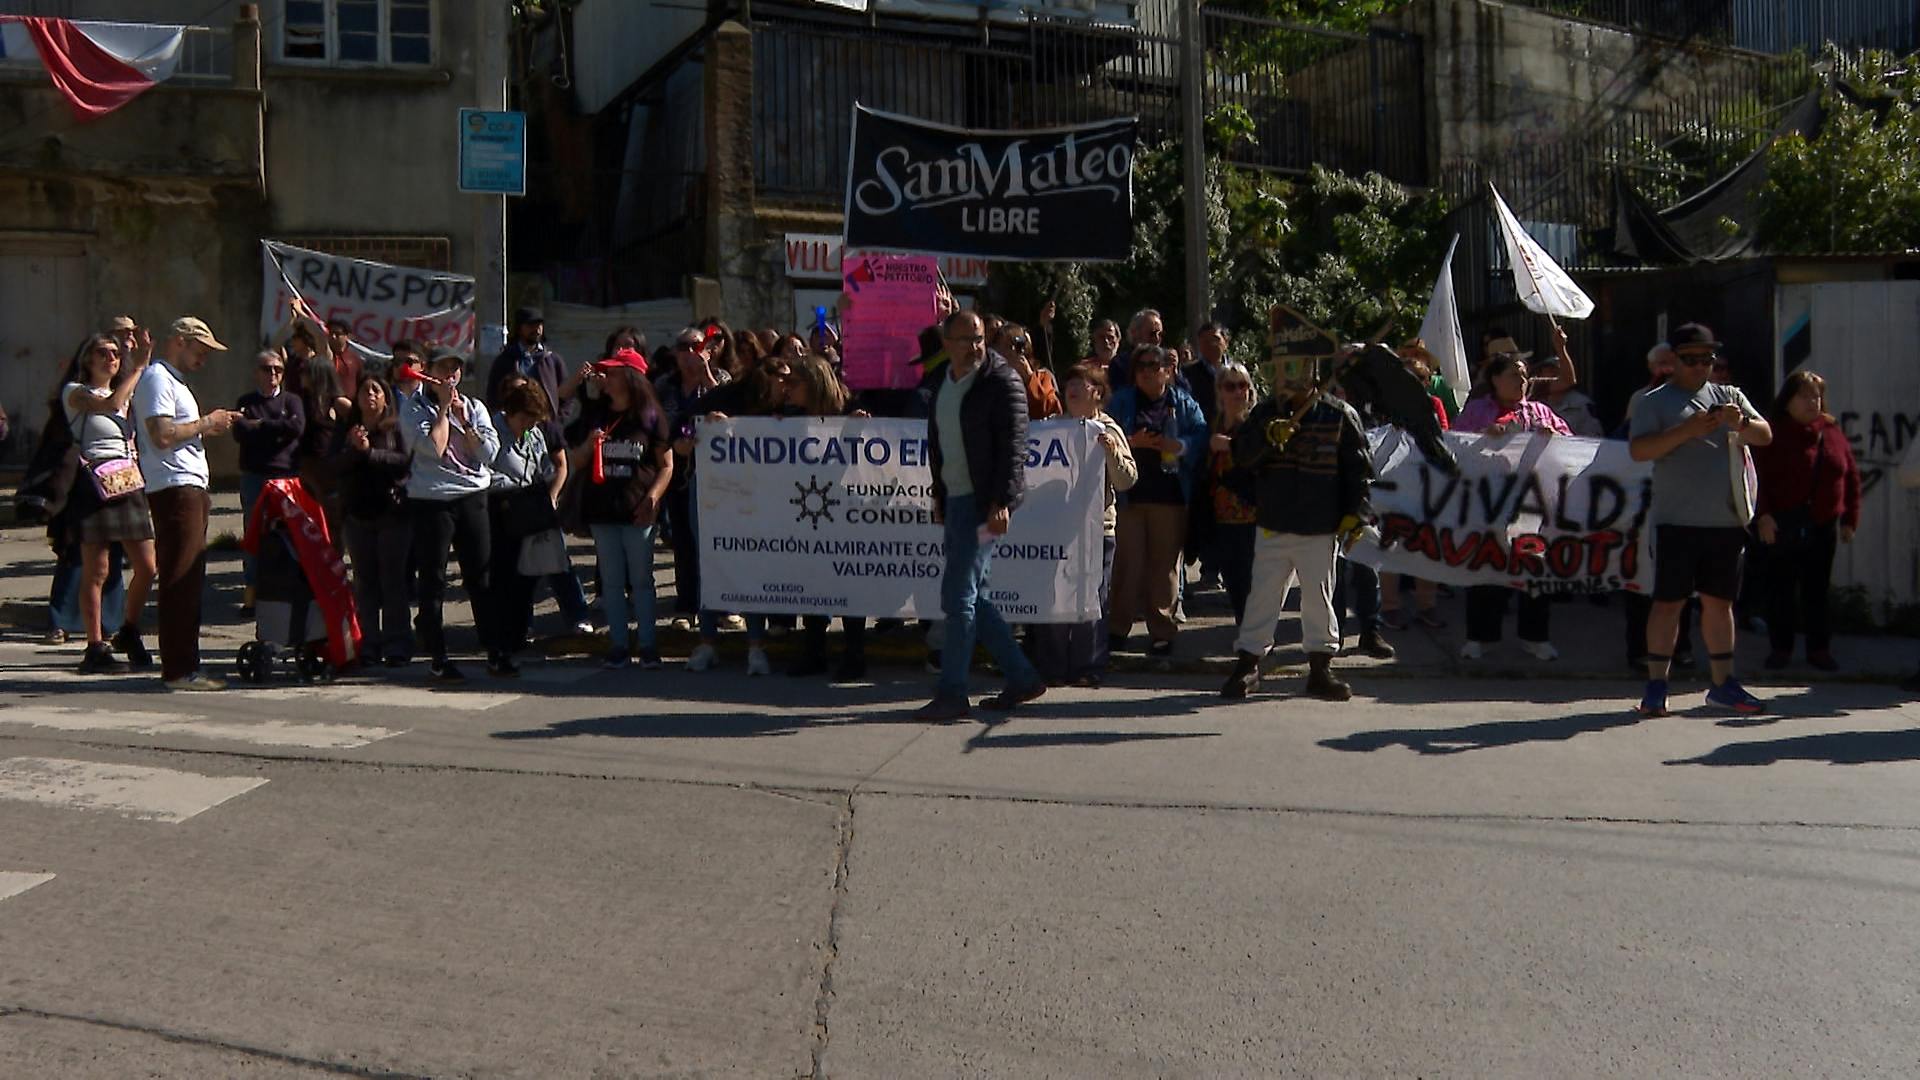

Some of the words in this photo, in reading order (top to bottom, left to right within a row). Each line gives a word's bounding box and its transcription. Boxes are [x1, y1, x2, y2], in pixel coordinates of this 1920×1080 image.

[961, 207, 1040, 234] LIBRE
[885, 262, 928, 273] NUESTRO
[709, 435, 892, 467] SINDICATO
[845, 507, 943, 525] CONDEL
[712, 535, 810, 555] FUNDACIÓN
[813, 539, 913, 557] ALMIRANTE
[832, 560, 941, 579] VALPARAÍSO
[762, 583, 804, 593] COLEGIO
[989, 591, 1020, 601] LEGIO
[799, 596, 849, 608] RIQUELME
